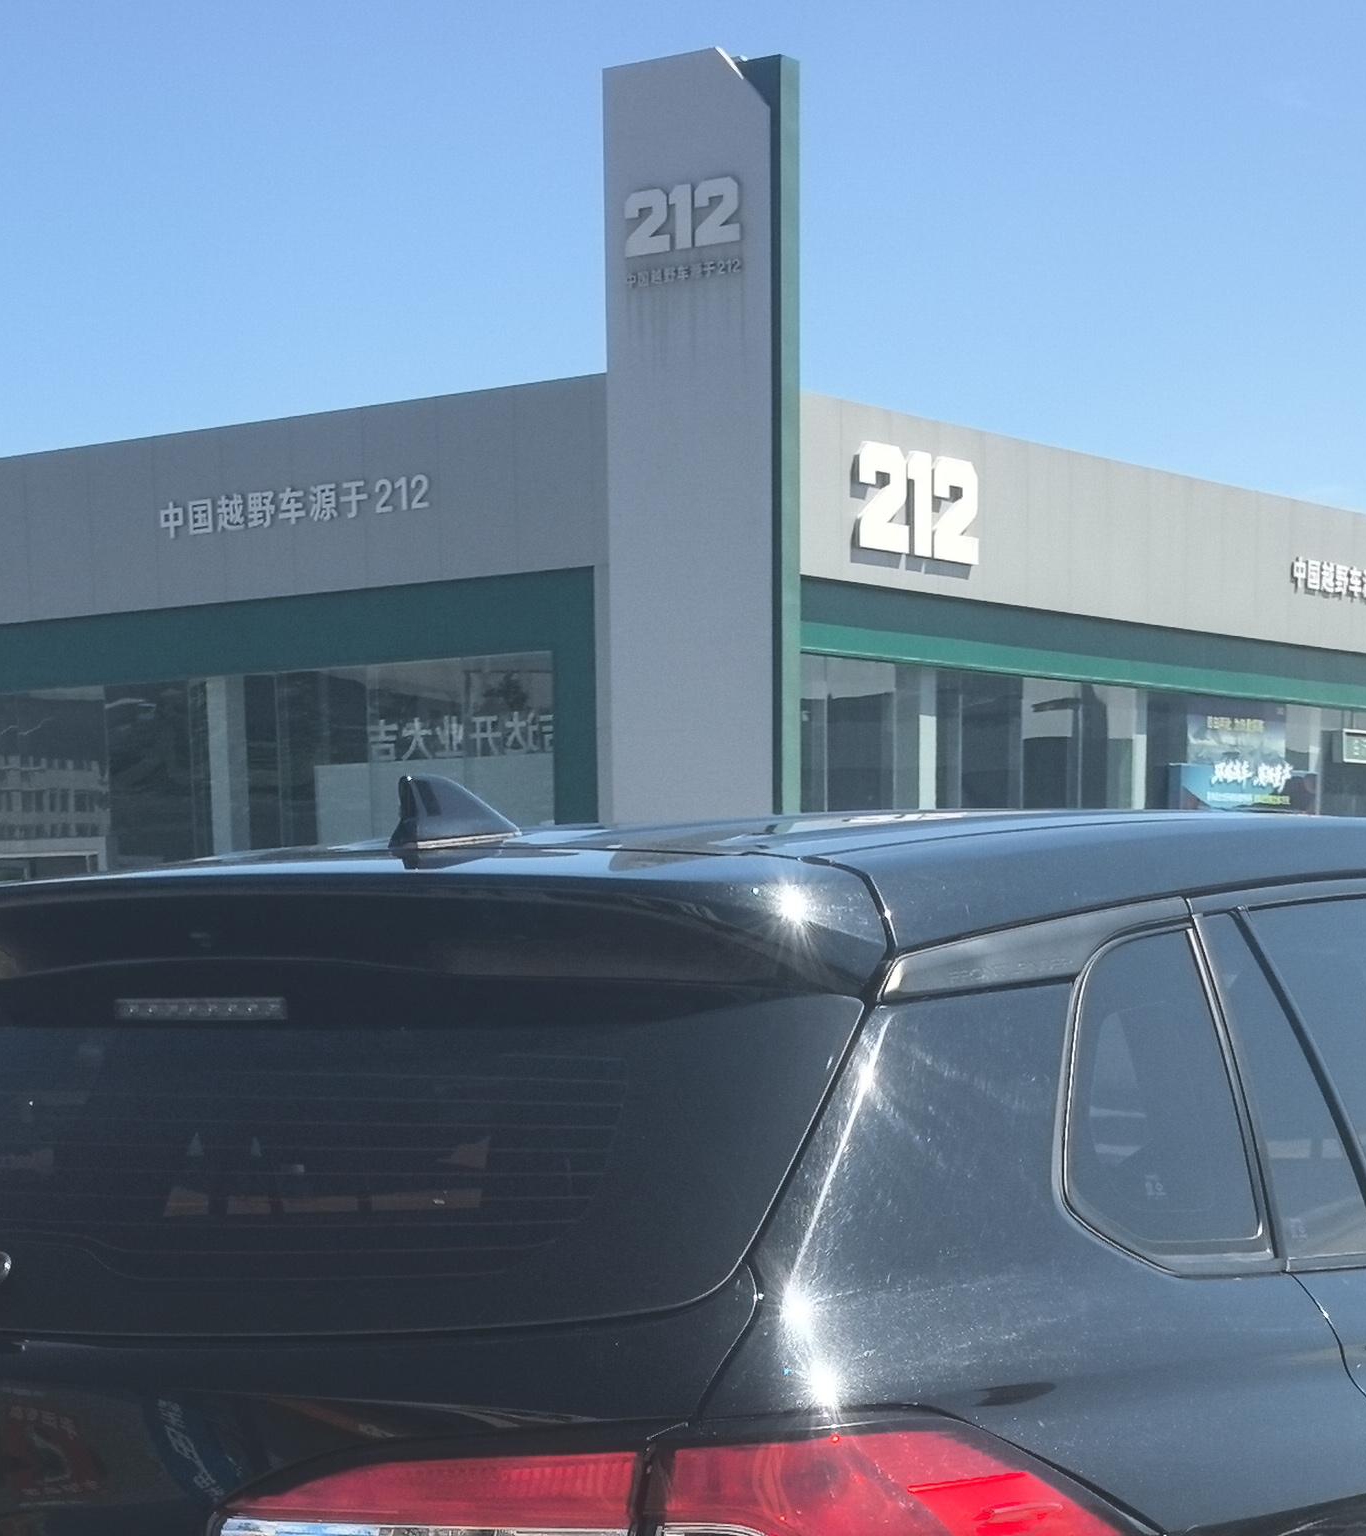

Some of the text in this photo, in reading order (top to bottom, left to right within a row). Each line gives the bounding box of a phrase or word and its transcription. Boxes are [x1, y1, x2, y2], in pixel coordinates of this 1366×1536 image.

[624, 176, 740, 258] 212
[159, 474, 430, 539] 中国越野车源于212
[853, 441, 979, 566] 212
